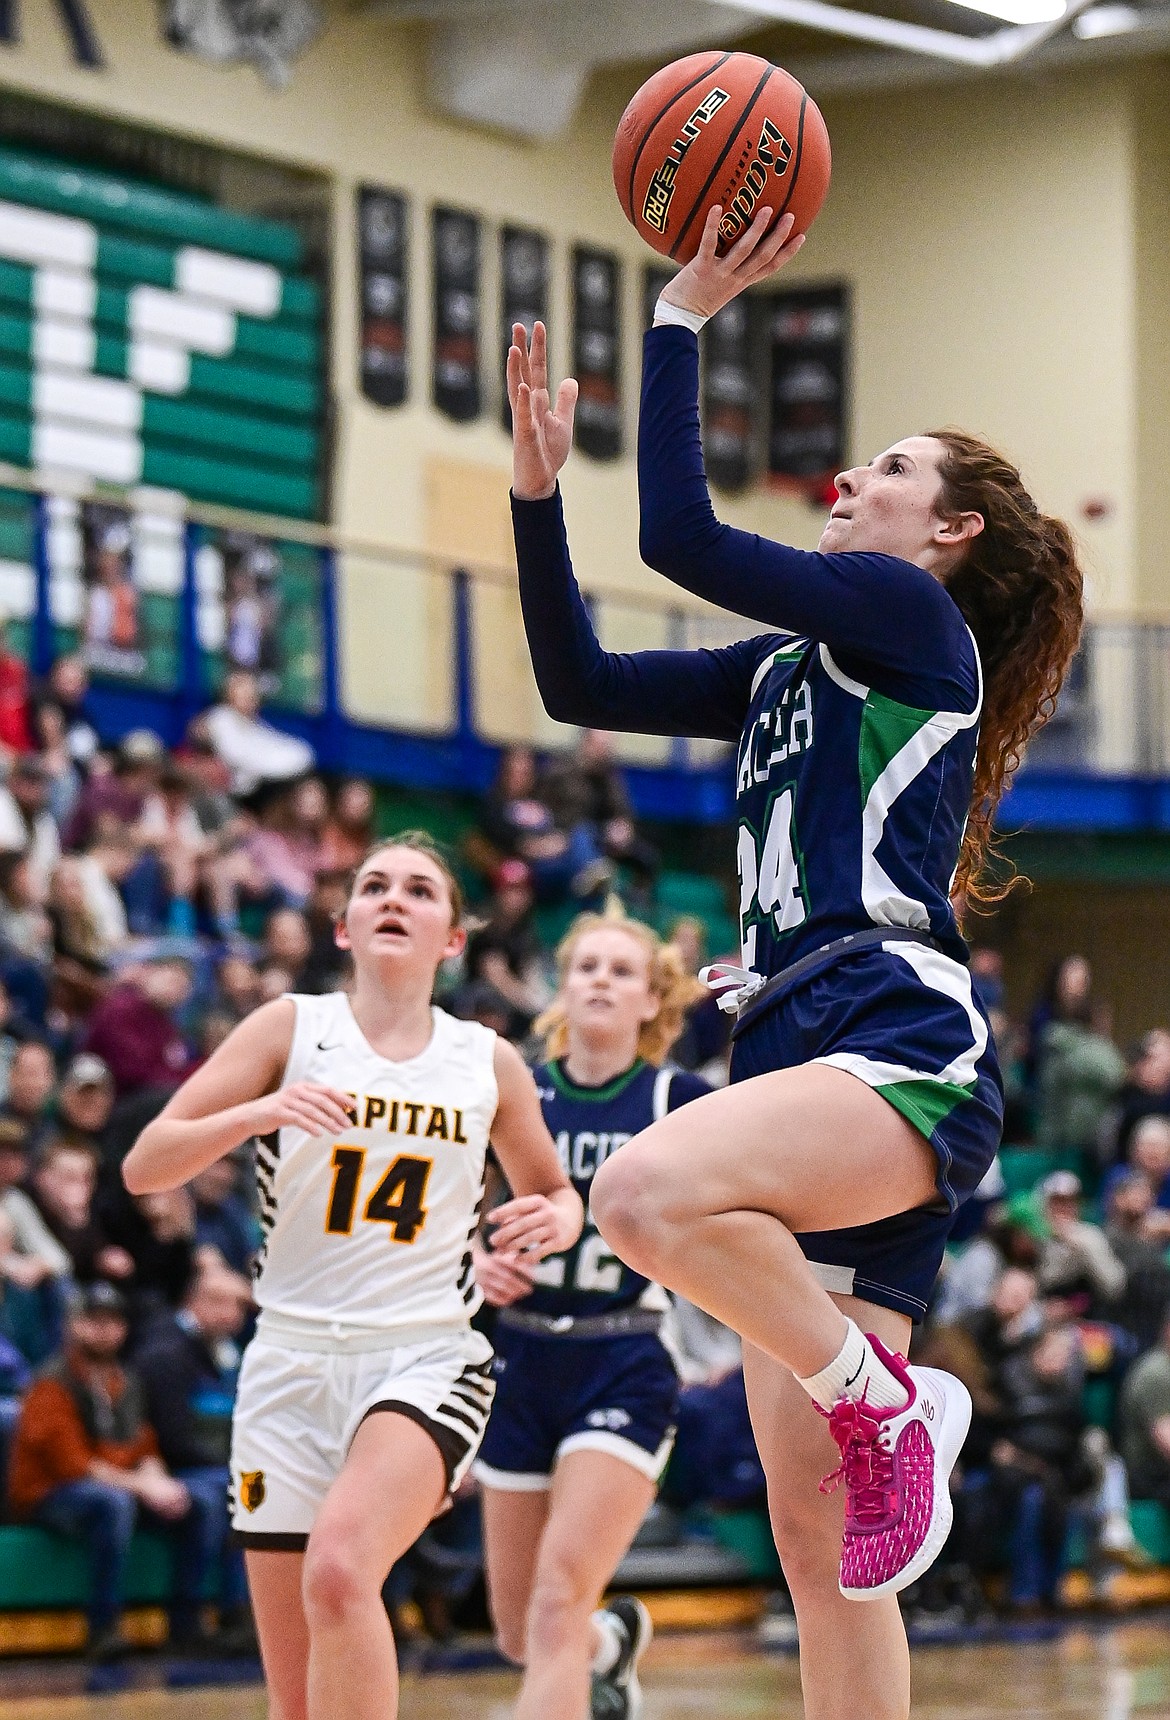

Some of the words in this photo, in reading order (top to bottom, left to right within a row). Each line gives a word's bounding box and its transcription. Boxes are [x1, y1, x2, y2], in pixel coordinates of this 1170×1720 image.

[656, 87, 731, 188] ELITE
[643, 178, 672, 232] PRO
[737, 785, 808, 972] 24
[325, 1144, 433, 1244] 14
